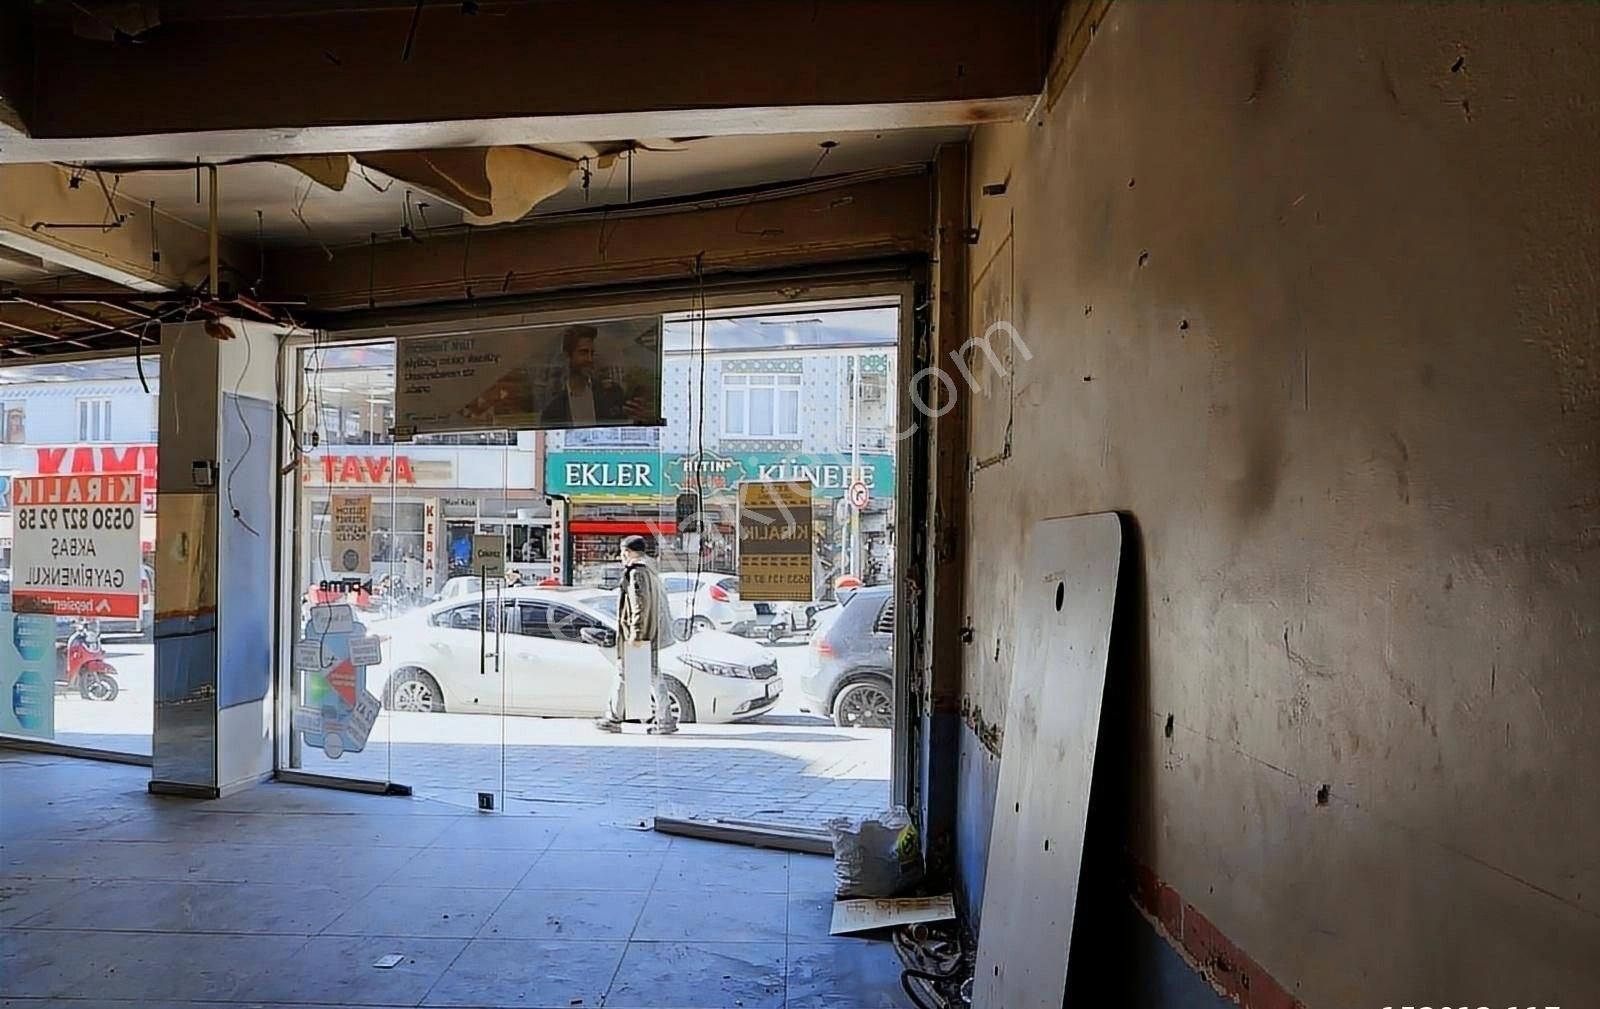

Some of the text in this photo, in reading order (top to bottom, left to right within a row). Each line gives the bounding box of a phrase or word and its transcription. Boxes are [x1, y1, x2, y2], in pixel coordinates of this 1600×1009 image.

[320, 455, 416, 484] TAVA
[564, 463, 654, 487] EKLER
[425, 505, 434, 588] KEBAP
